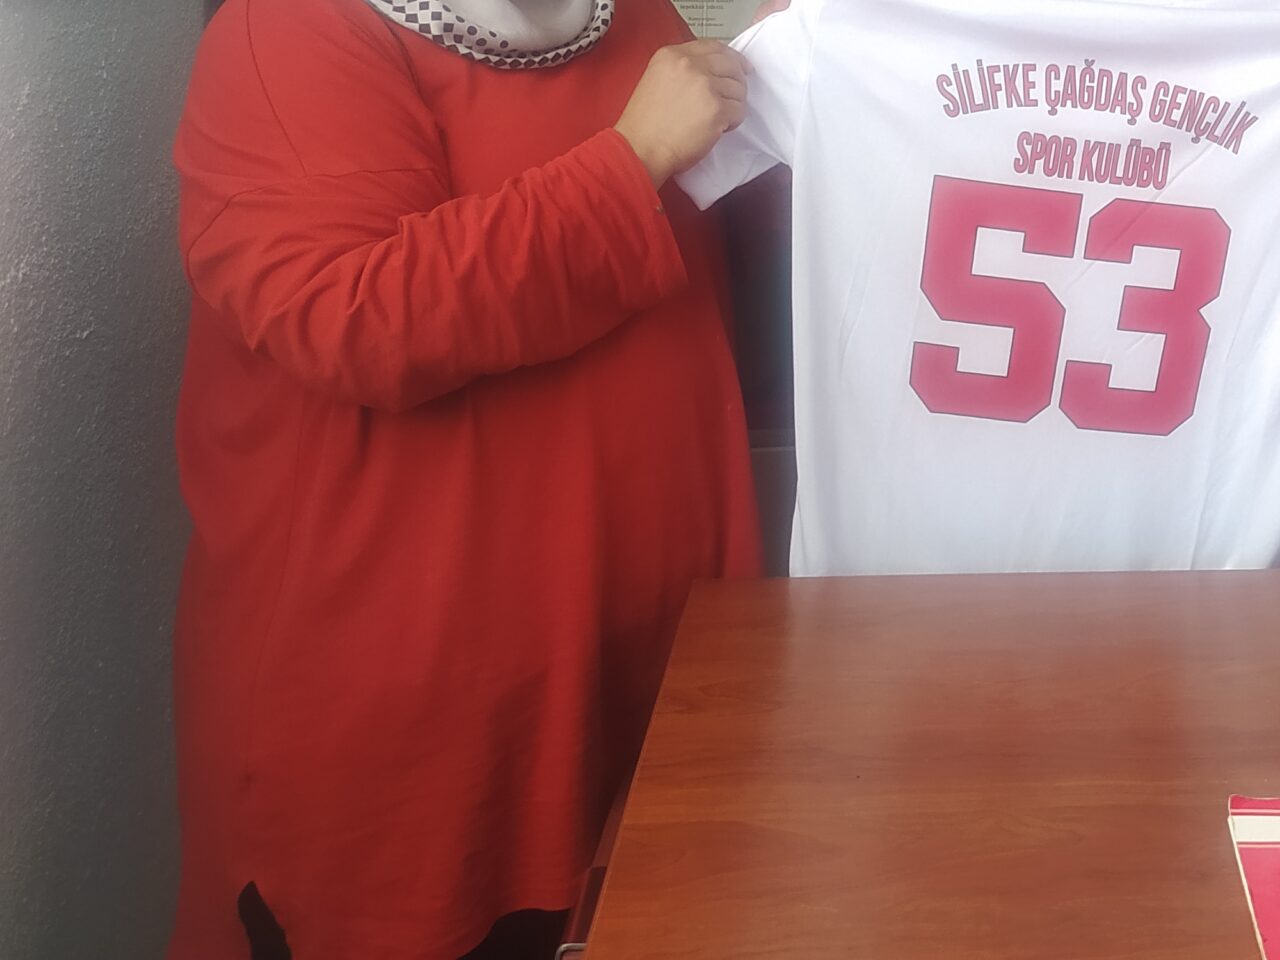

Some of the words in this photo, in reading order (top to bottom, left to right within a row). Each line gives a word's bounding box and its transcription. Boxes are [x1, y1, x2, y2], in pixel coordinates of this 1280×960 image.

[935, 58, 1039, 118] SİLİFKE
[1044, 59, 1148, 126] ÇAĞDAŞ
[1149, 80, 1259, 155] GENÇLİK
[1013, 130, 1079, 180] SPOR
[1078, 138, 1172, 191] KULÜBÜ
[908, 174, 1232, 436] 53
